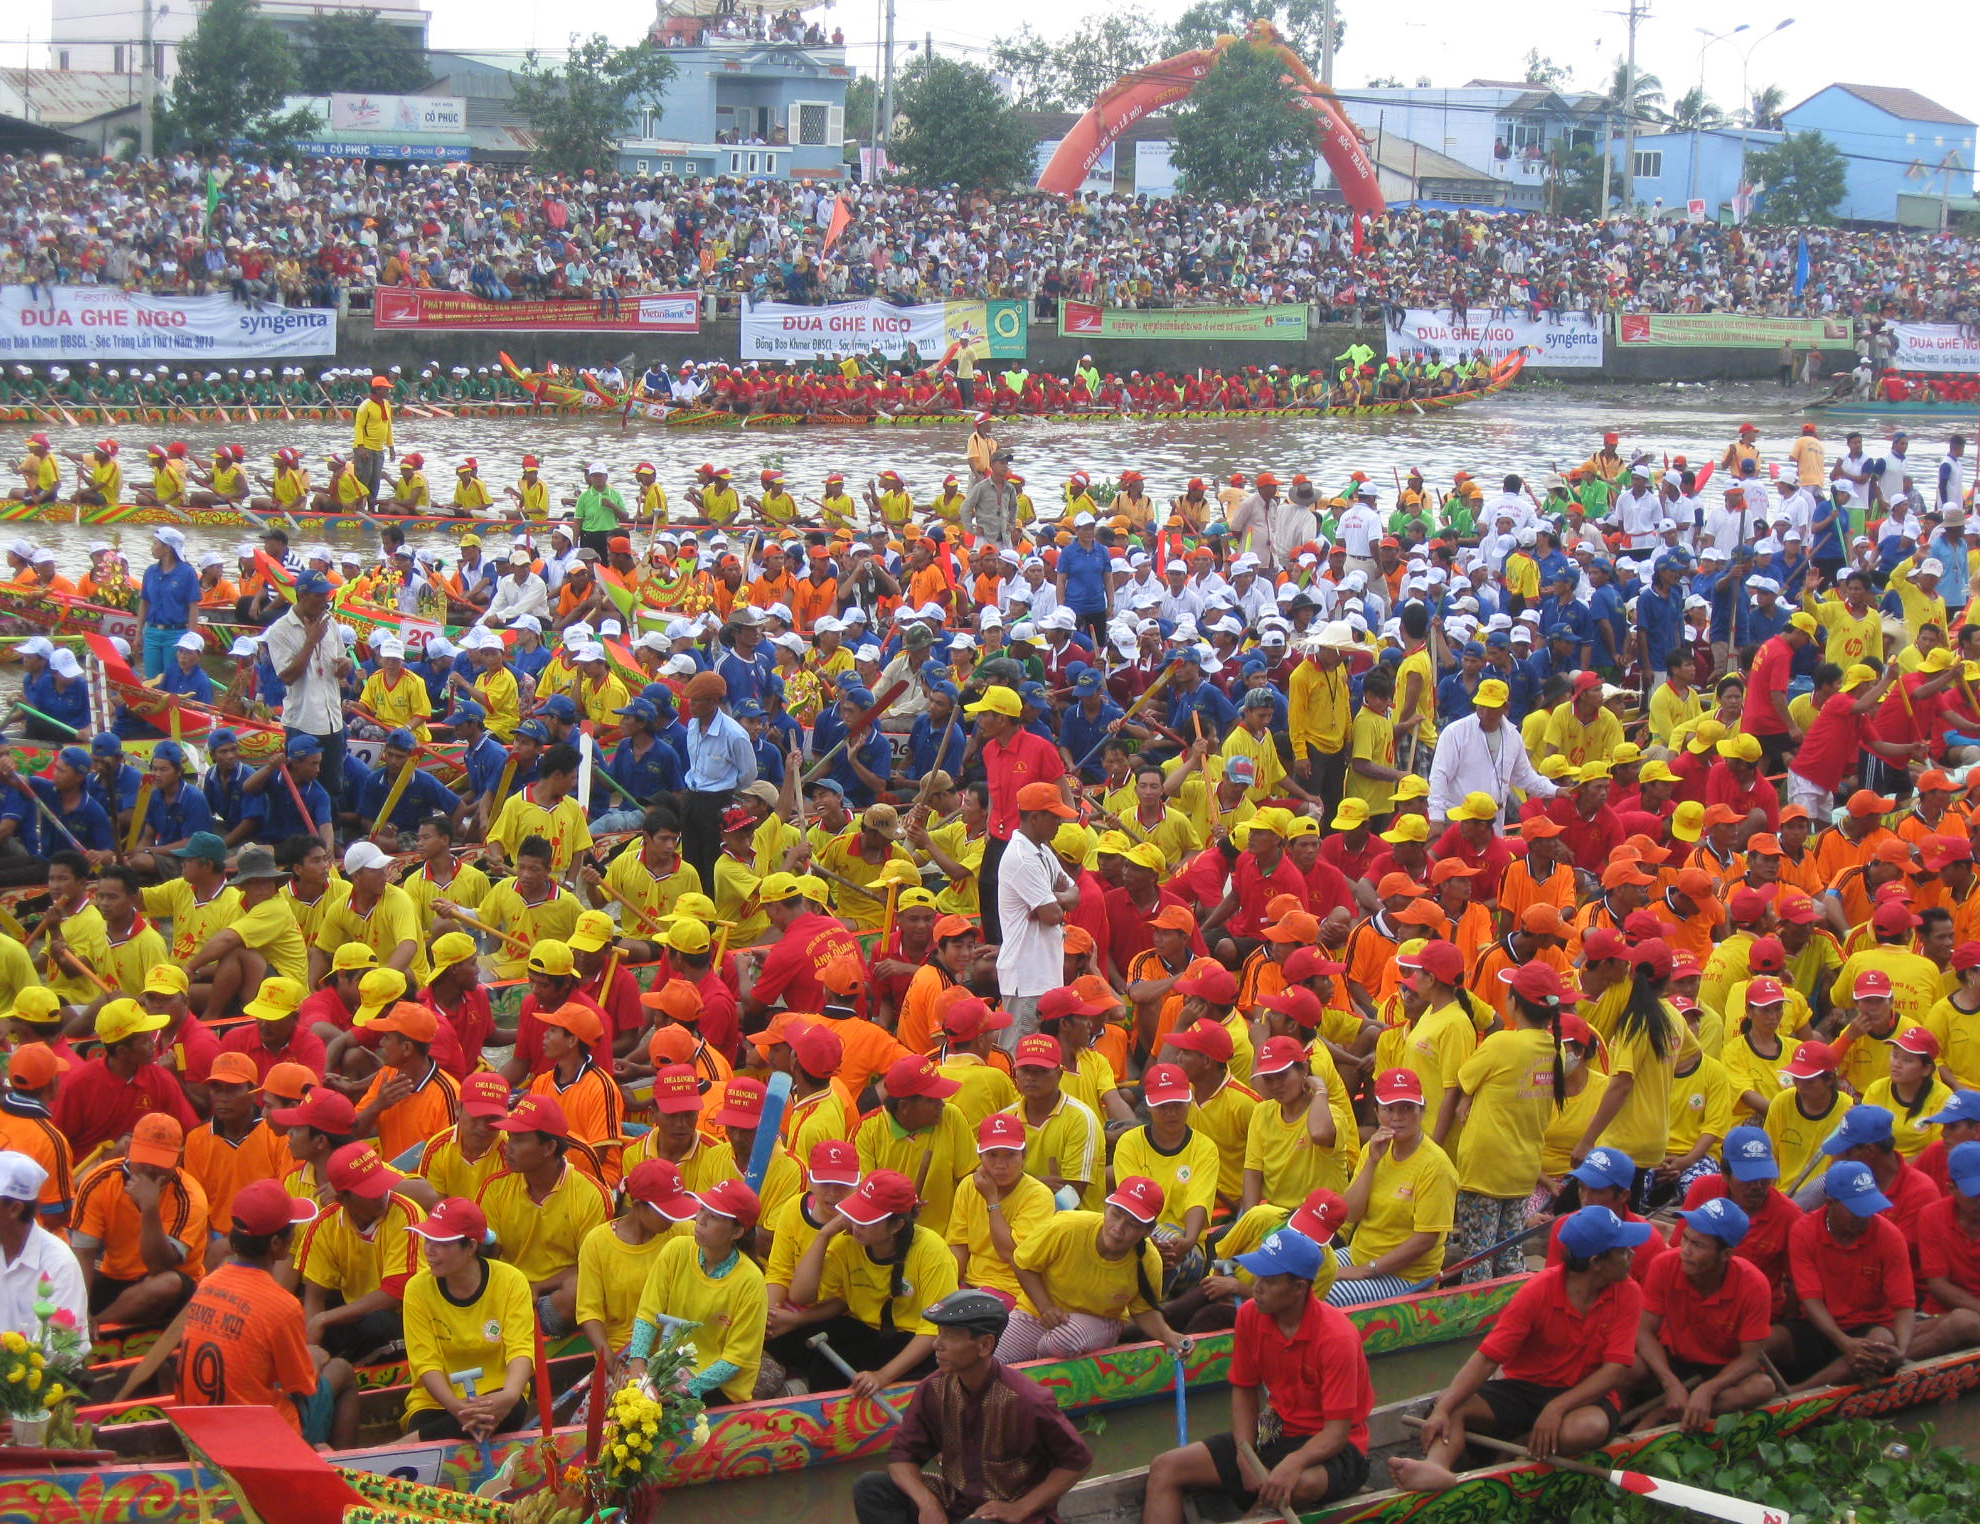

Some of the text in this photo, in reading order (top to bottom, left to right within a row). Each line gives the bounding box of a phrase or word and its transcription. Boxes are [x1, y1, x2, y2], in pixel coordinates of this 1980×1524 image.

[80, 309, 129, 327] GHE
[136, 310, 188, 328] NGO
[641, 309, 685, 319] VietinBank
[239, 312, 328, 335] syngenta
[829, 316, 866, 332] GHE
[1452, 327, 1480, 342] GHE
[1484, 328, 1515, 342] NGO
[1545, 331, 1599, 349] syngenta
[919, 337, 937, 350] 2013
[1937, 337, 1960, 350] GHE
[586, 396, 600, 405] 02
[652, 408, 665, 417] 29
[109, 621, 137, 637] 06
[407, 629, 436, 650] 20
